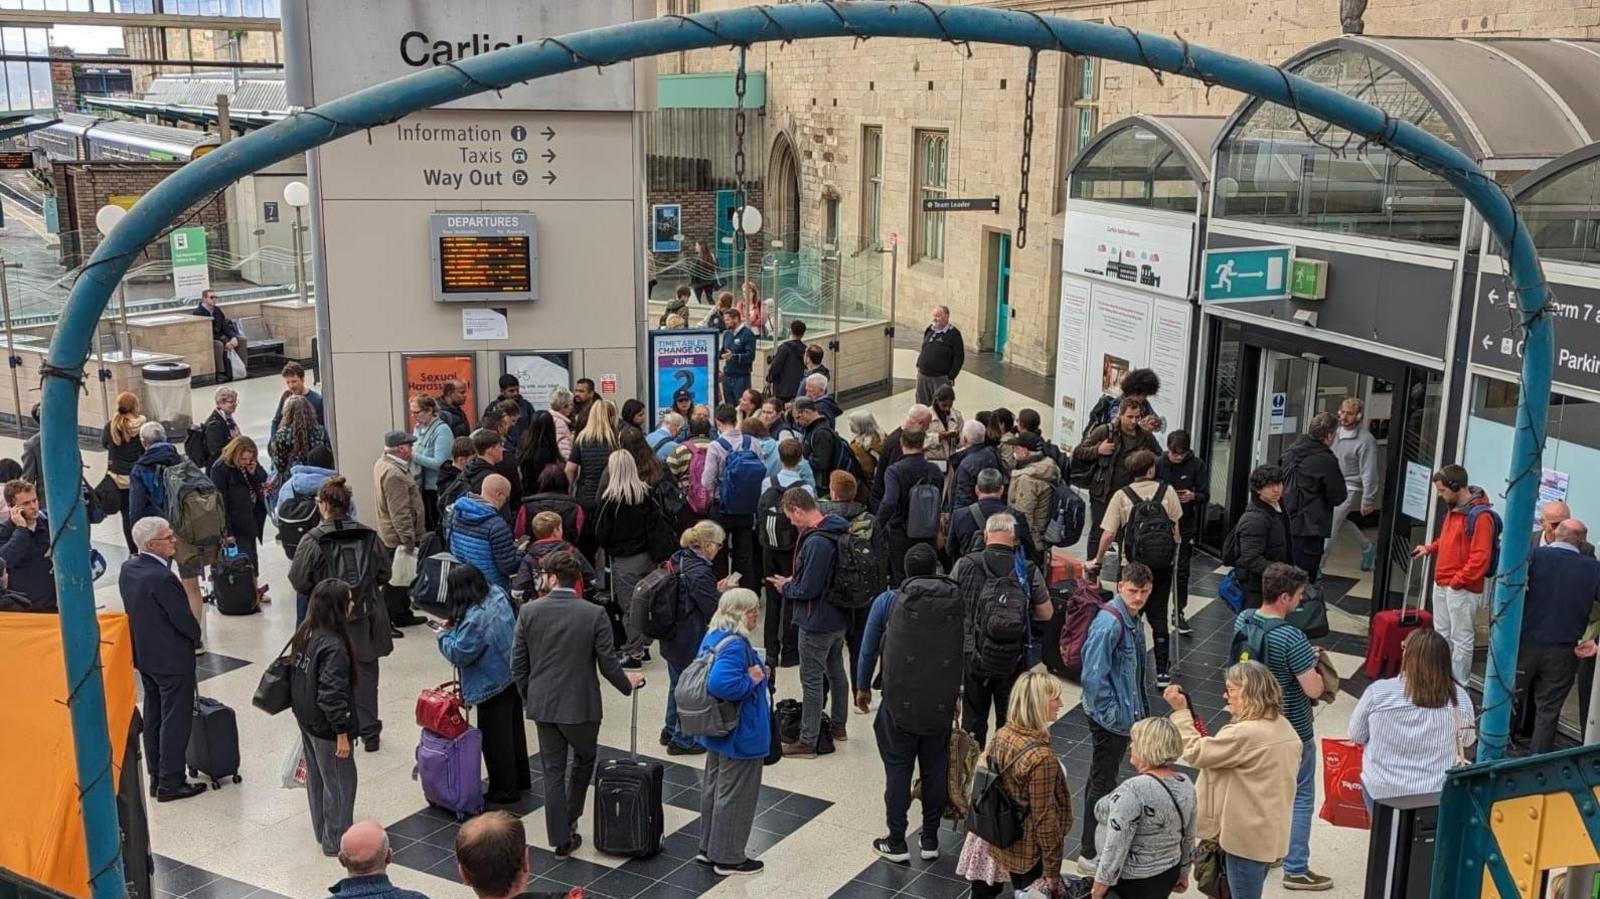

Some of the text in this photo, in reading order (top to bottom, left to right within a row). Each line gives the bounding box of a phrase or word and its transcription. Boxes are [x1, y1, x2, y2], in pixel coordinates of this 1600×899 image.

[400, 31, 523, 66] Carli
[397, 123, 502, 141] Information
[459, 147, 502, 164] Taxis
[424, 169, 503, 190] Way Out
[447, 216, 519, 227] DEPARTURES
[1584, 304, 1594, 321] 7
[672, 357, 695, 365] JUNE
[1559, 348, 1600, 374] Parki
[420, 372, 457, 382] Sexual
[673, 370, 695, 398] 2
